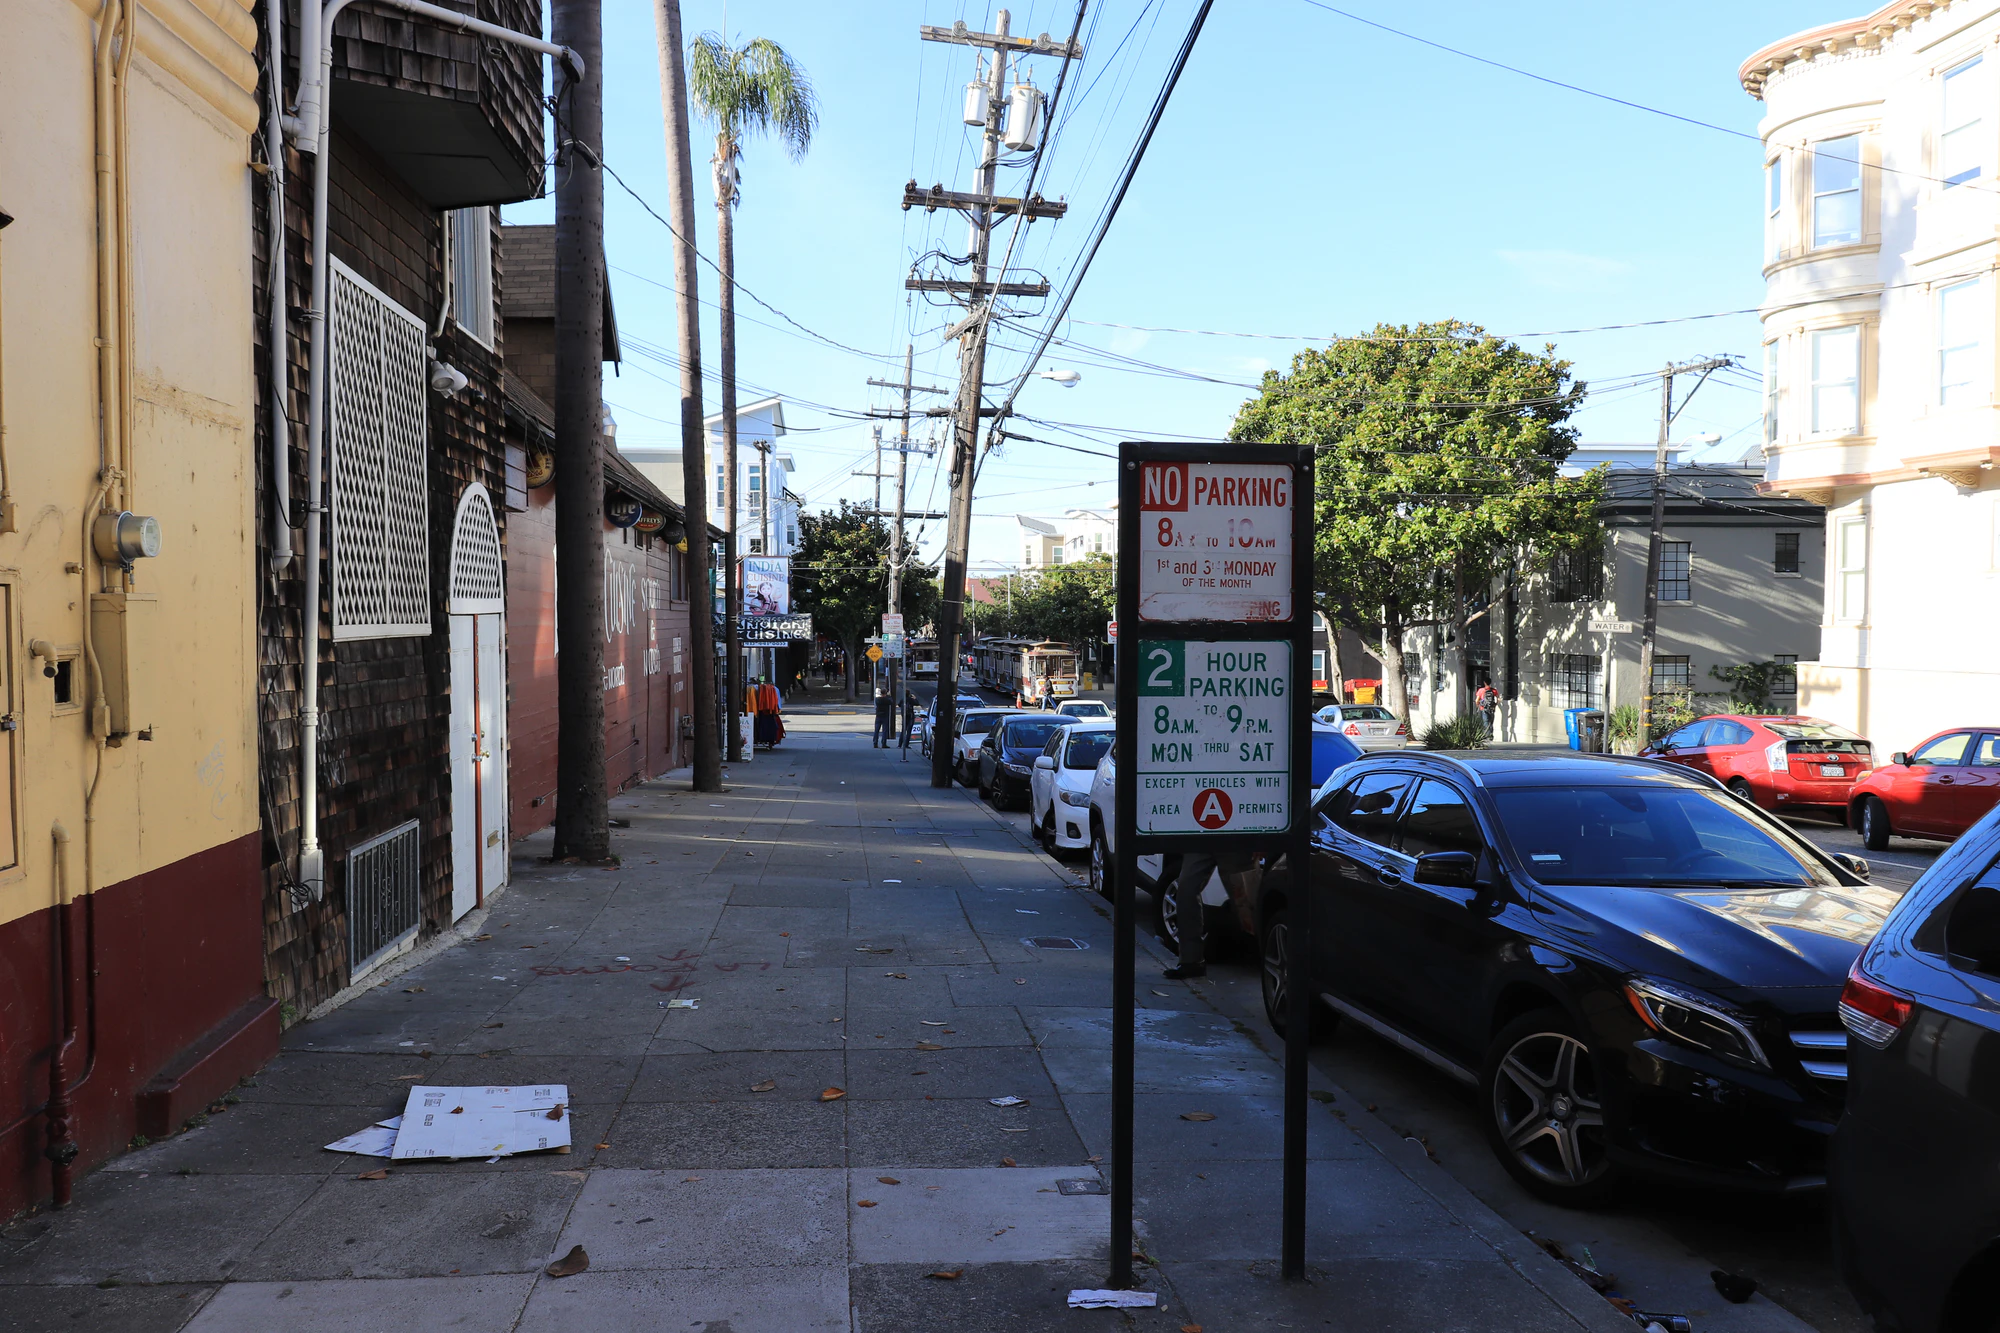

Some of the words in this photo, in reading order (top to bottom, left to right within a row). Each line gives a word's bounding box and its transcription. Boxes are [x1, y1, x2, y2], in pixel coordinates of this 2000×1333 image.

[1145, 466, 1182, 506] NO
[1194, 476, 1286, 507] PARKING
[1157, 559, 1170, 574] 1st
[1174, 560, 1197, 575] and
[1224, 561, 1276, 576] MONDAY
[1182, 577, 1194, 587] OF
[1198, 578, 1215, 588] THE
[1219, 579, 1252, 589] MONTH
[1147, 648, 1173, 687] 2
[1207, 652, 1267, 672] HOUR
[1189, 677, 1284, 697] PARKING
[1203, 705, 1218, 715] TO
[1151, 743, 1193, 763] MON
[1204, 743, 1229, 753] THRU
[1239, 743, 1274, 762] SAT
[1145, 778, 1185, 789] EXCEPT
[1195, 777, 1246, 788] VEHICLES
[1255, 777, 1280, 788] WITH
[1151, 804, 1180, 815] AREA
[1199, 792, 1226, 822] A
[1239, 803, 1283, 814] PERMITS
